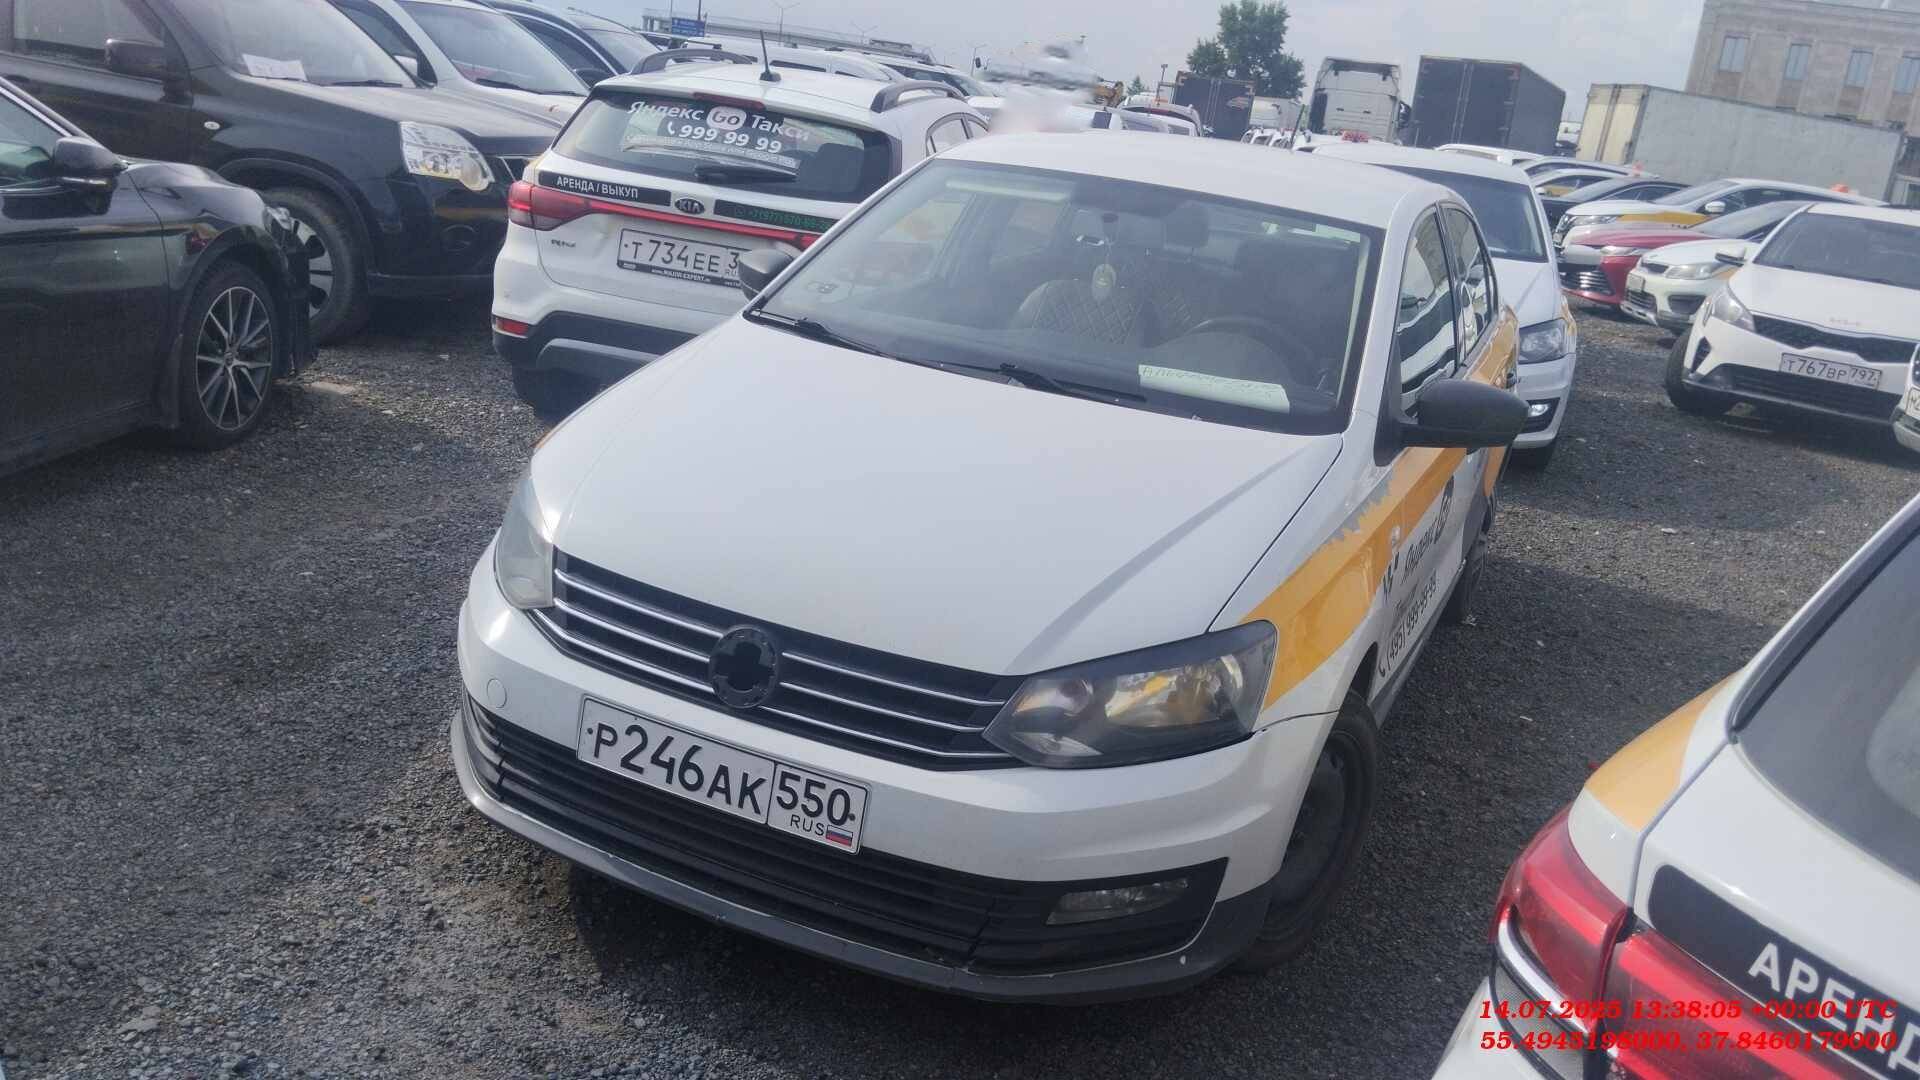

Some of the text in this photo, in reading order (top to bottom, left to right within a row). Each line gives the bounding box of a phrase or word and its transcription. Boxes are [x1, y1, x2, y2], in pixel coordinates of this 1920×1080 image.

[627, 101, 705, 122] Яндекс
[751, 114, 810, 142] Такси
[678, 124, 718, 142] 999
[723, 131, 750, 147] 99
[755, 137, 783, 154] 99
[556, 175, 595, 193] АРЕНДА
[602, 183, 639, 199] ВЫКУП
[679, 199, 703, 213] KIA
[728, 251, 740, 270] 3
[1787, 358, 1848, 381] Т767ВР
[593, 722, 851, 827] Р246АК 550
[789, 813, 825, 837] RUS
